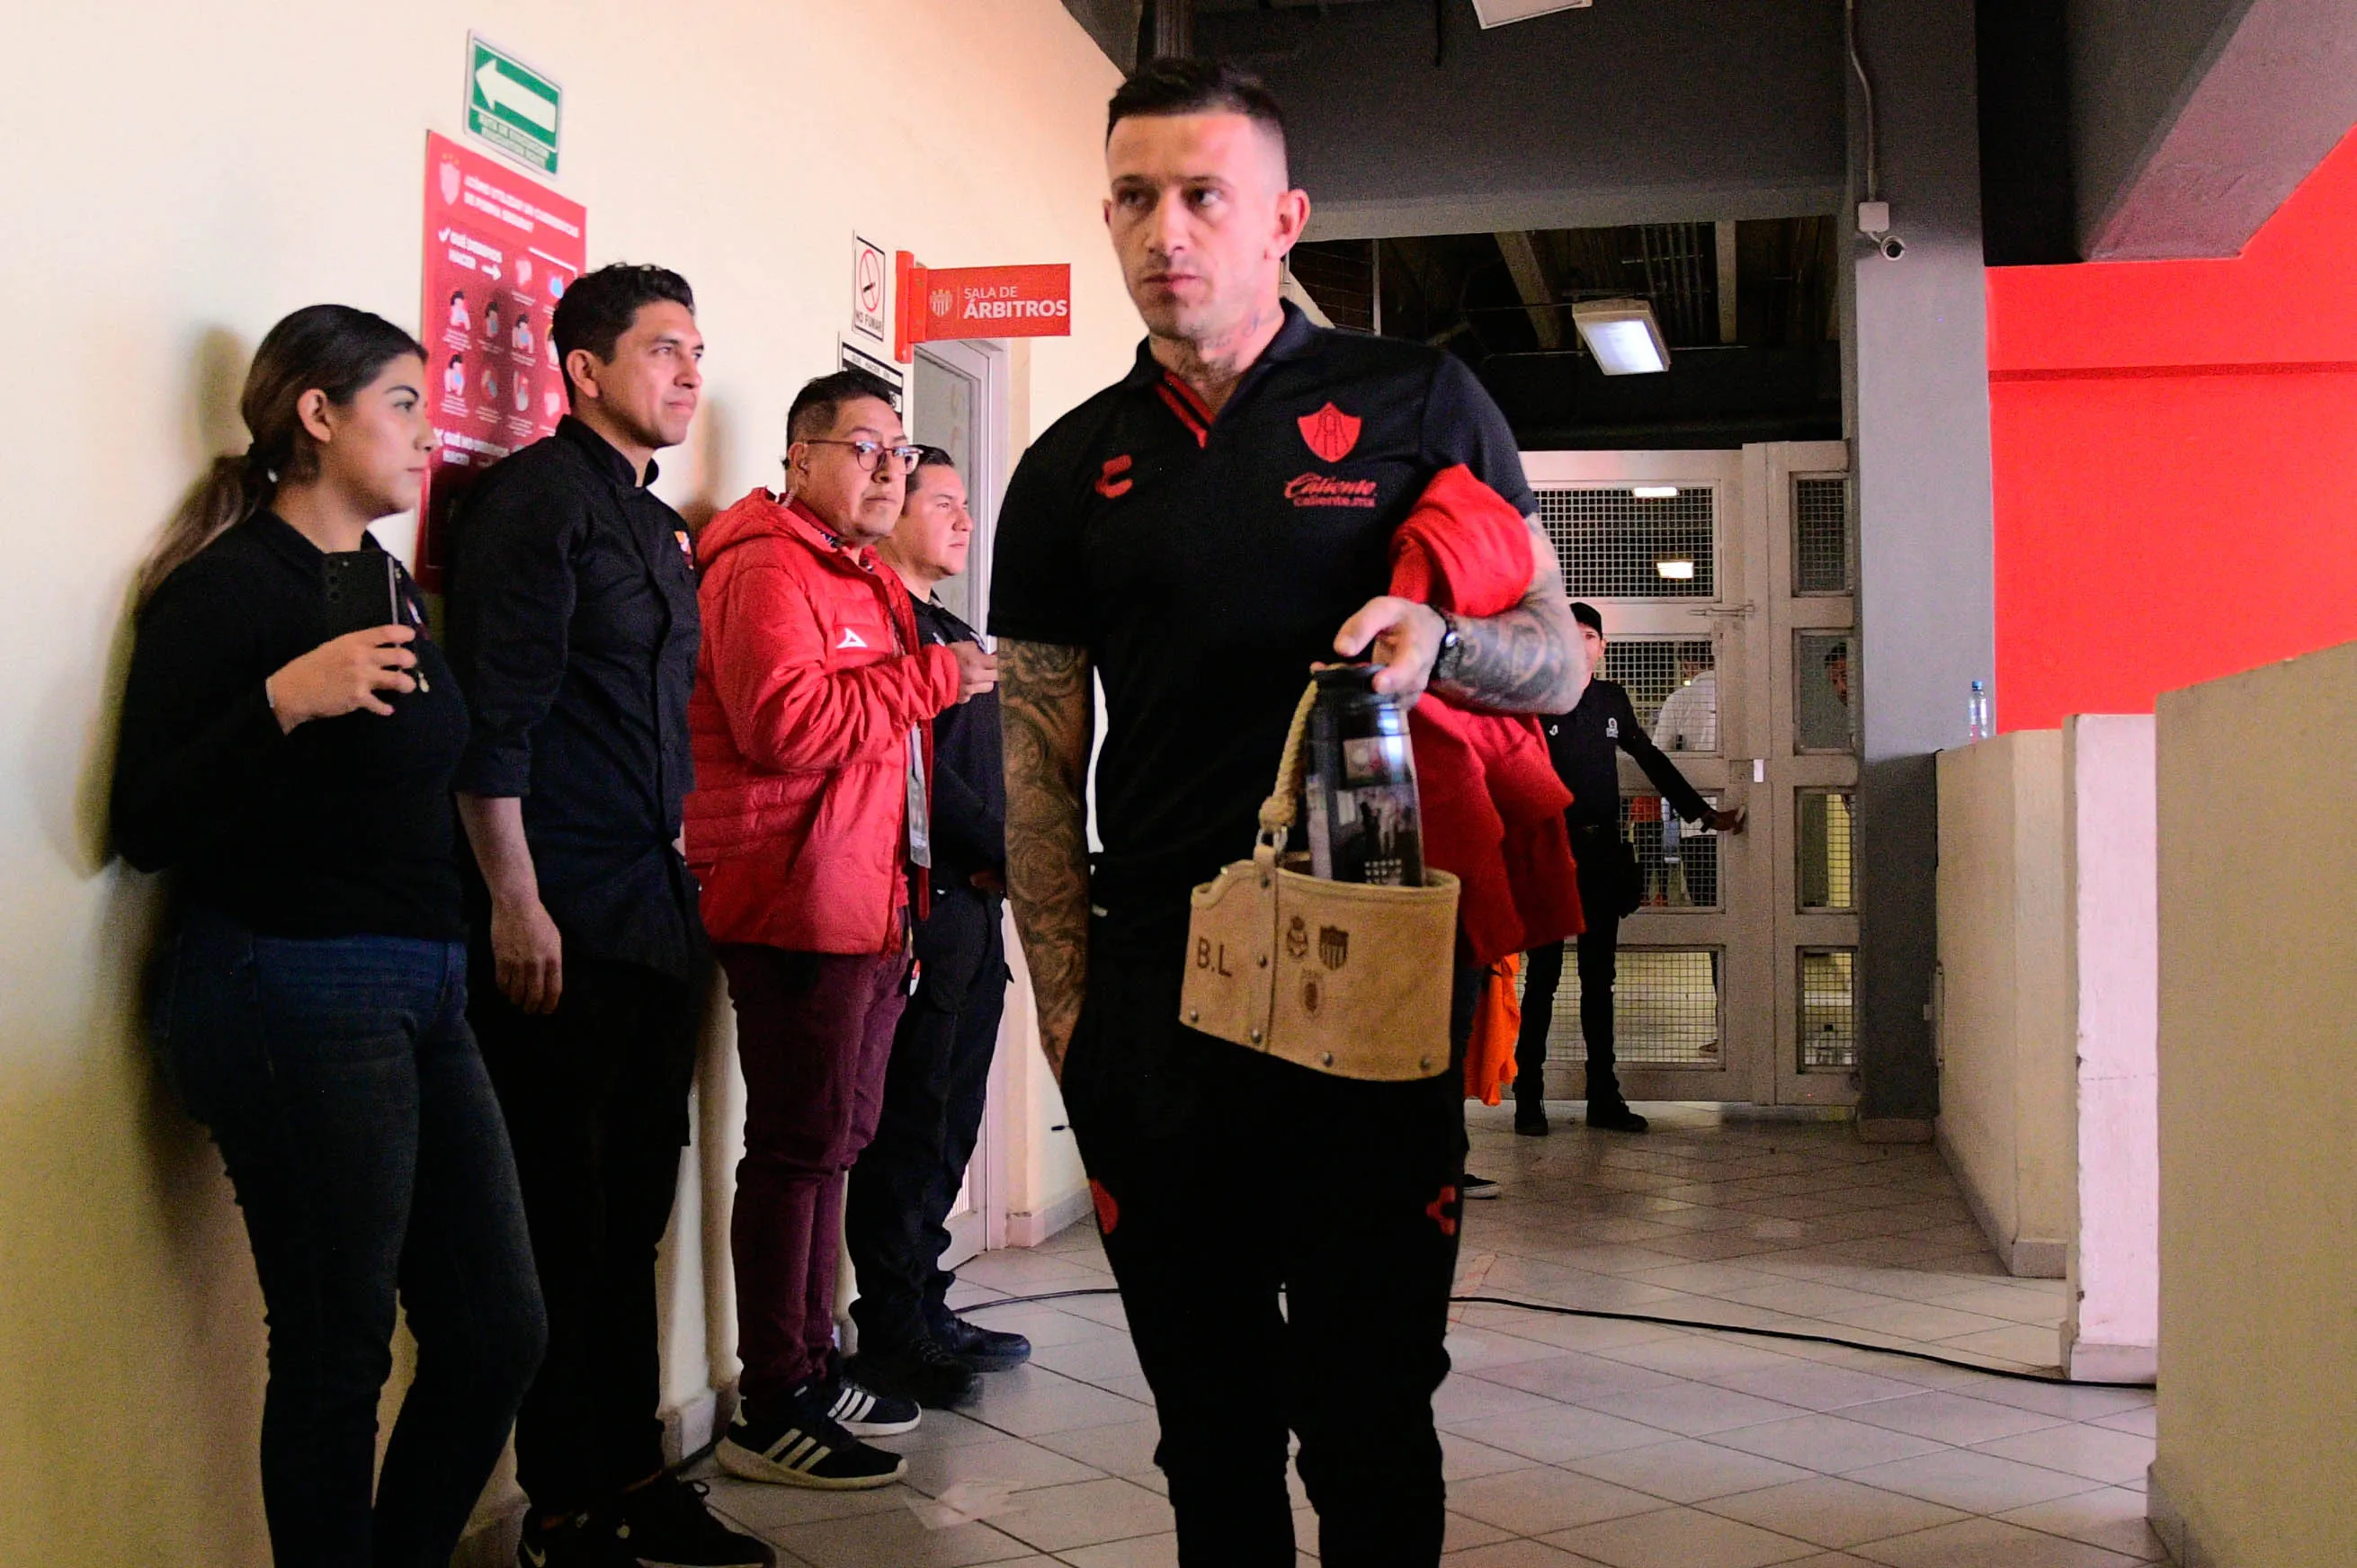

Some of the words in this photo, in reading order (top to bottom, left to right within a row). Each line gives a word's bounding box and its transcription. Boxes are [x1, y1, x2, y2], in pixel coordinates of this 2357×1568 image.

[963, 288, 997, 299] SALA
[999, 286, 1018, 298] DE
[963, 298, 1068, 319] ÁRBITROS
[855, 310, 863, 324] NO
[864, 314, 882, 333] FUMAR
[1283, 471, 1377, 499] Caliente
